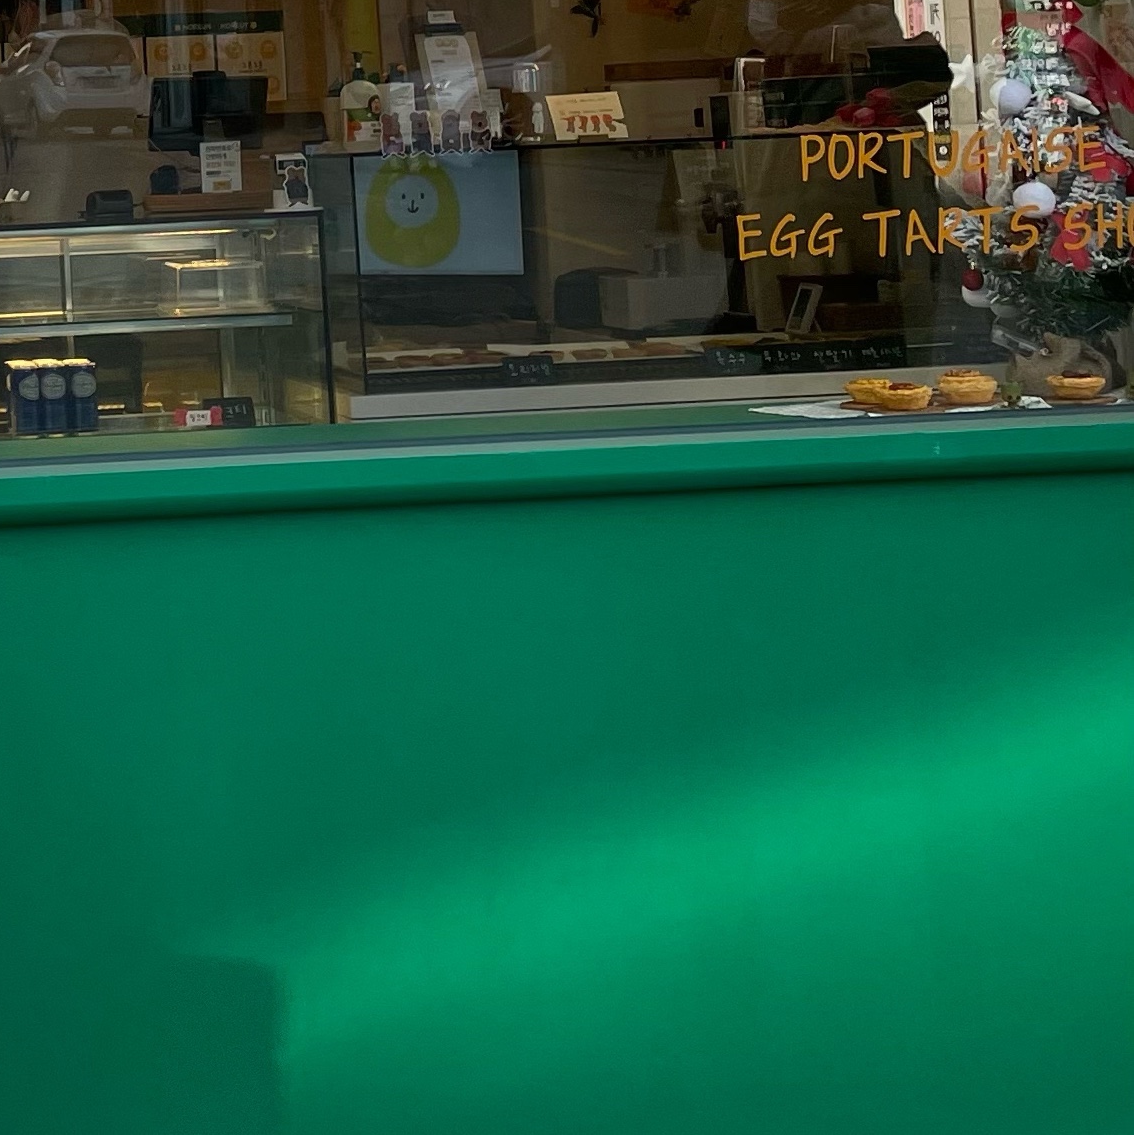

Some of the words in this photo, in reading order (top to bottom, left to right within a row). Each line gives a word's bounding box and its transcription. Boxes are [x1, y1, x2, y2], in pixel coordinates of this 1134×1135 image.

[799, 125, 1107, 182] PORTUGAISE
[736, 211, 843, 261] EGG
[862, 204, 1040, 258] TARTS
[1062, 200, 1134, 251] SH
